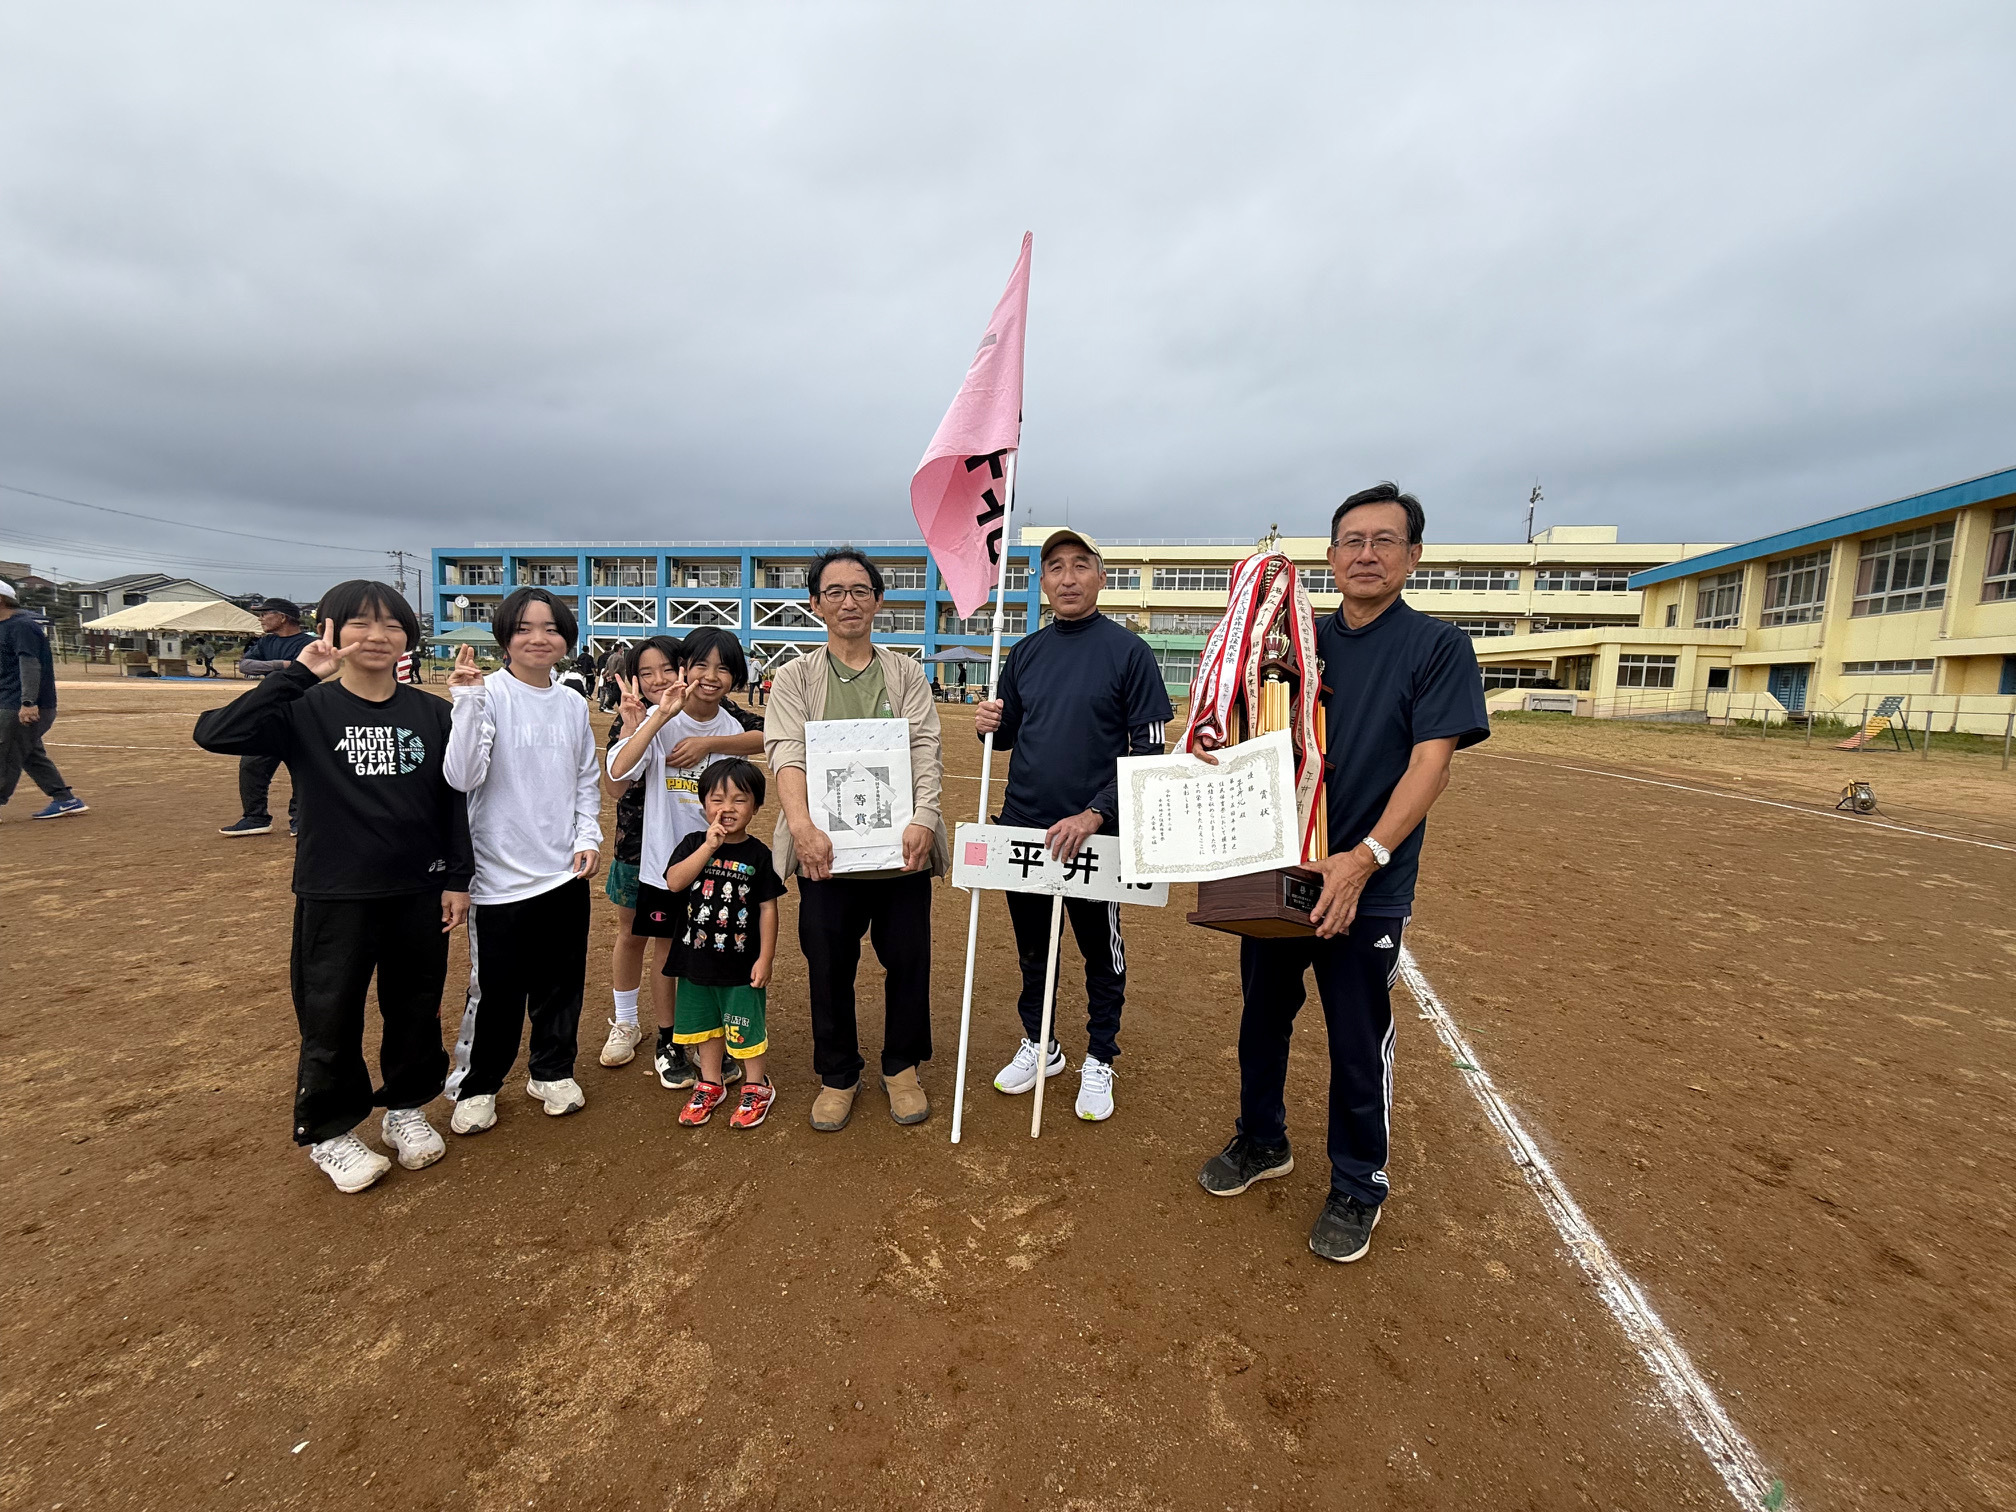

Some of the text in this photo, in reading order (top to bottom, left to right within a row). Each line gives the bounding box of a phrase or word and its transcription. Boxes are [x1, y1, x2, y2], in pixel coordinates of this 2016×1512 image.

[345, 726, 393, 739] EVERY
[334, 738, 395, 751] MINUTE
[348, 750, 395, 763] EVERY
[355, 762, 397, 776] GAME
[853, 777, 867, 826] 一等賞
[1259, 788, 1270, 818] 賞状
[723, 859, 756, 876] HERO
[704, 868, 749, 881] ULTRA KAIJU
